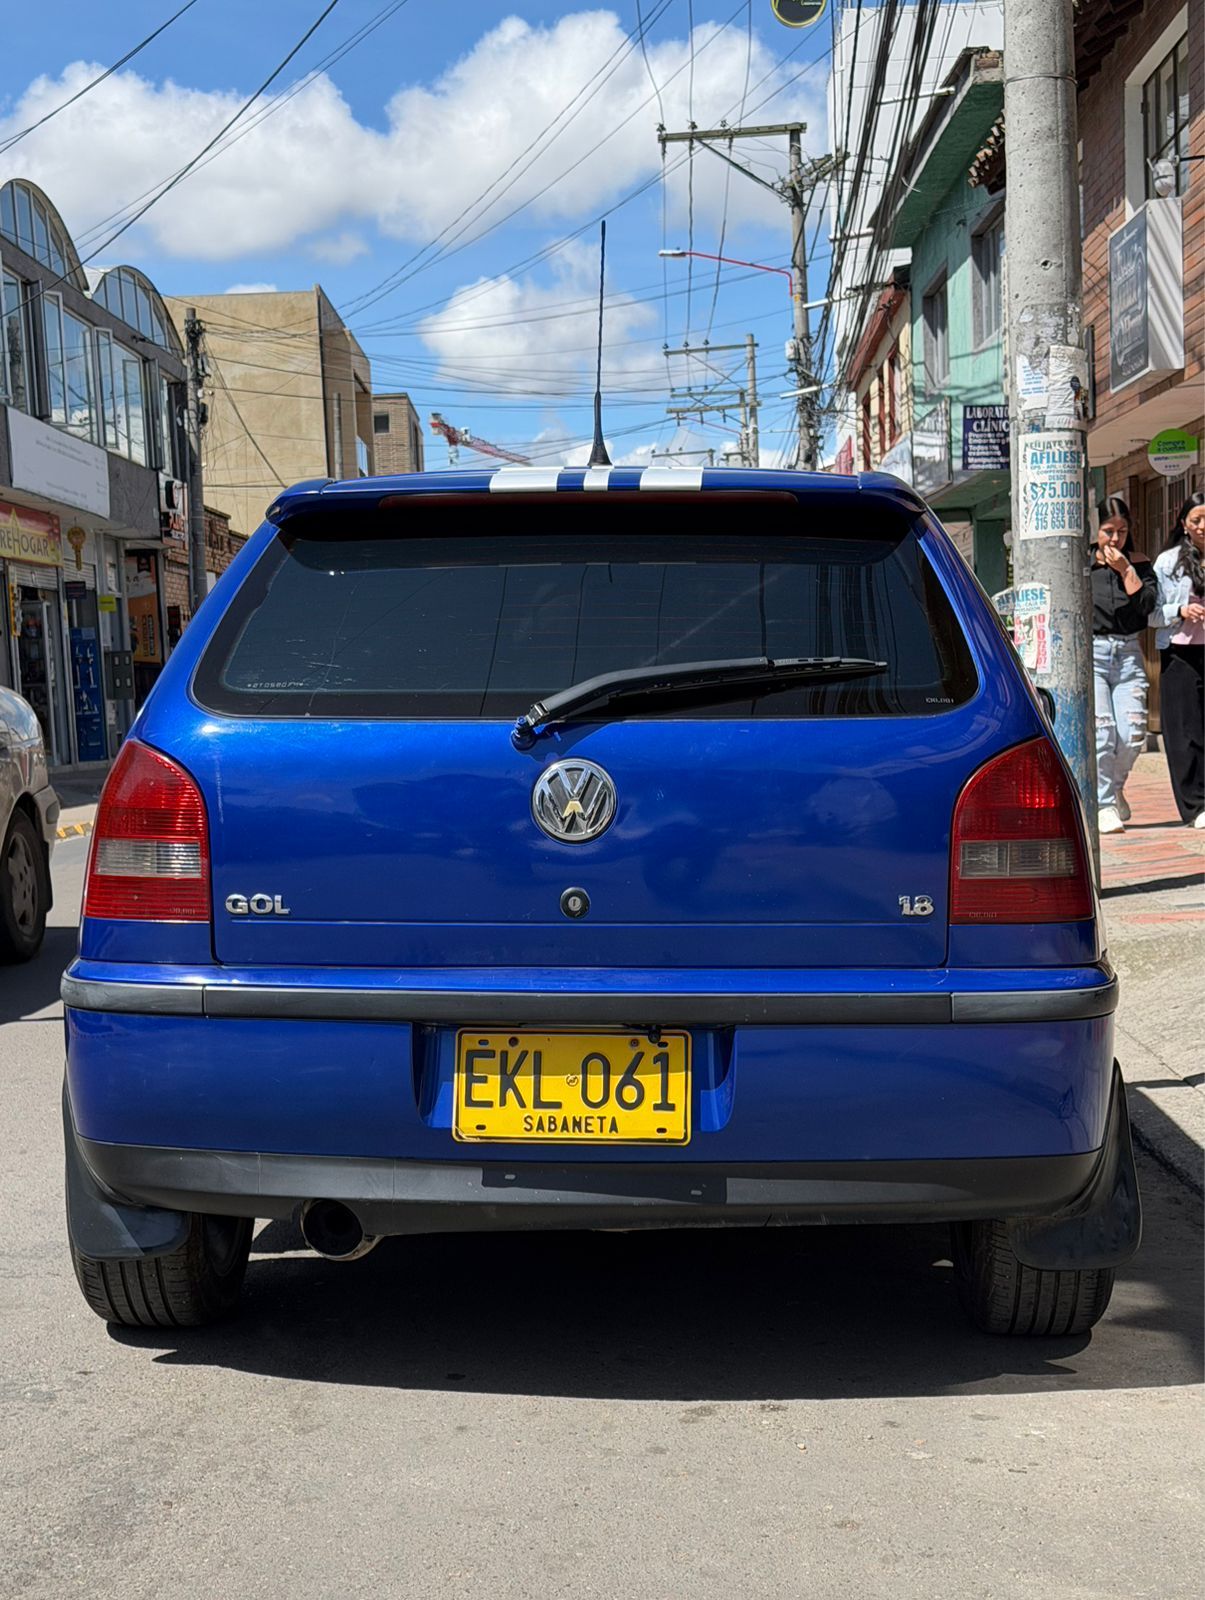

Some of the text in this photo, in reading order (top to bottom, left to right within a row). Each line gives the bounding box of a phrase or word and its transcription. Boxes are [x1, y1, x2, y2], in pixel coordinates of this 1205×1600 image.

[1030, 451, 1081, 465] AFILIESE
[1030, 481, 1081, 500] $75.000
[225, 893, 290, 915] GOL
[464, 1049, 675, 1111] EKL 061
[523, 1115, 619, 1134] SABANETA
